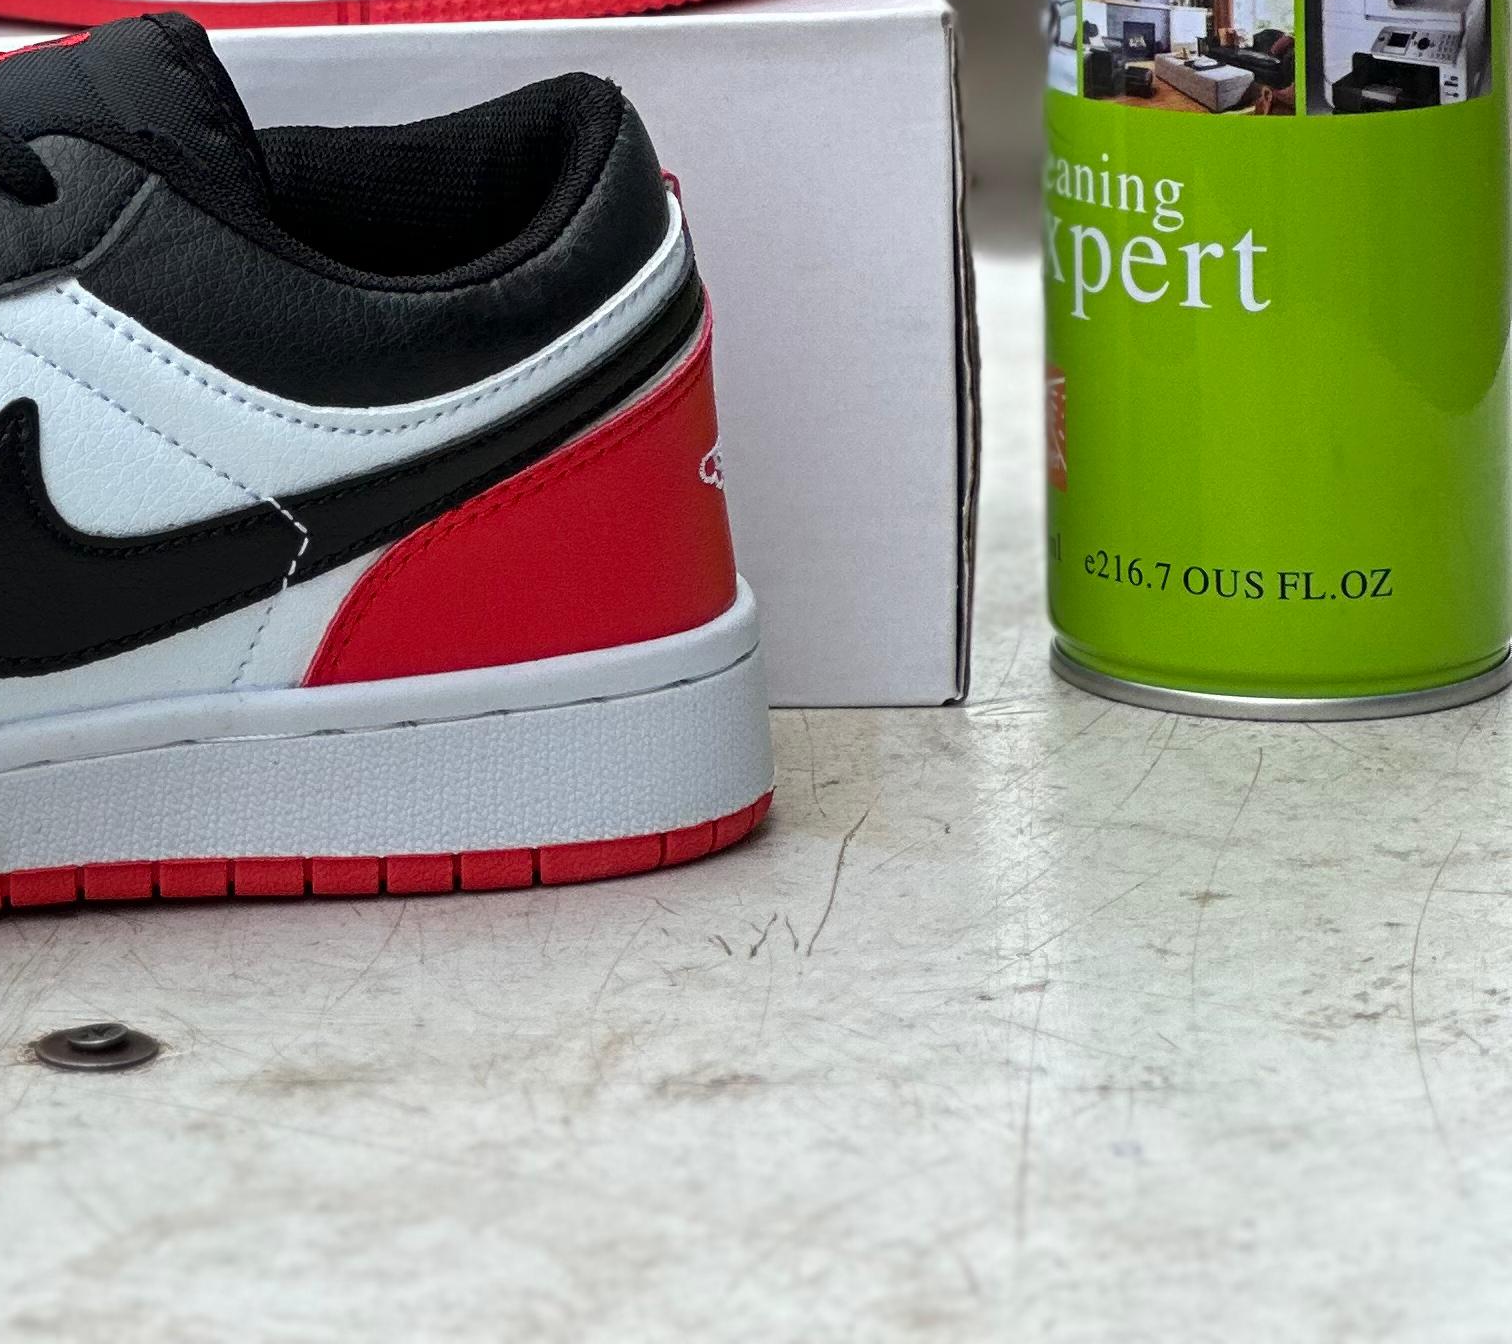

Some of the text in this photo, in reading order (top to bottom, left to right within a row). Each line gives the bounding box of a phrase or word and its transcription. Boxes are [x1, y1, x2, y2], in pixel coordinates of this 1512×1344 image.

[1084, 549, 1394, 601] e216.7 OUS FL.OZ
